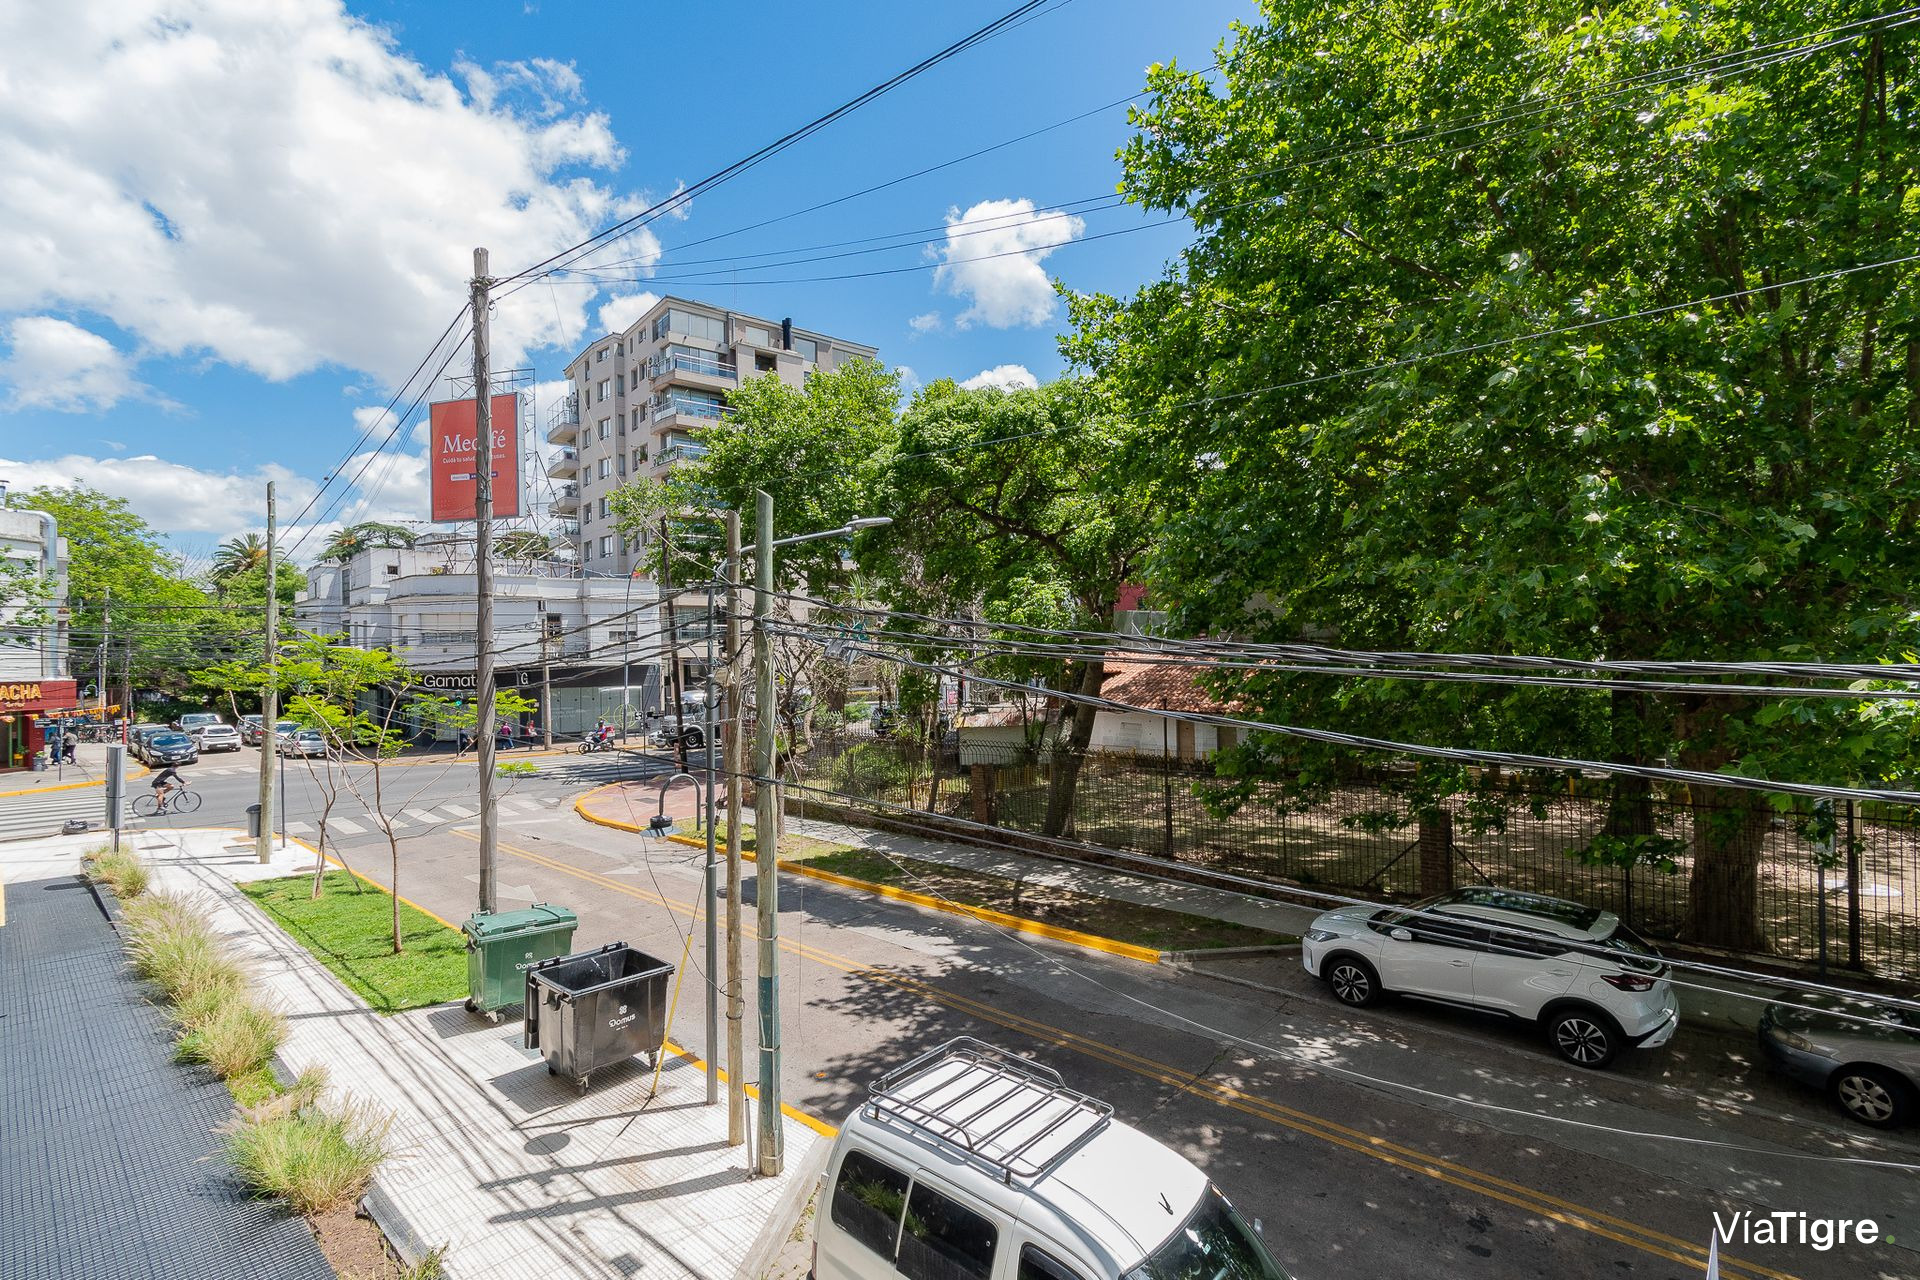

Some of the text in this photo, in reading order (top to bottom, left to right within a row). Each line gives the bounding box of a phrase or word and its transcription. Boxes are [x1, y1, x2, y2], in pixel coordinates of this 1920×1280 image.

[442, 430, 506, 454] Mefé
[424, 674, 478, 688] Gamat
[520, 672, 529, 685] G
[608, 1013, 636, 1028] Domus
